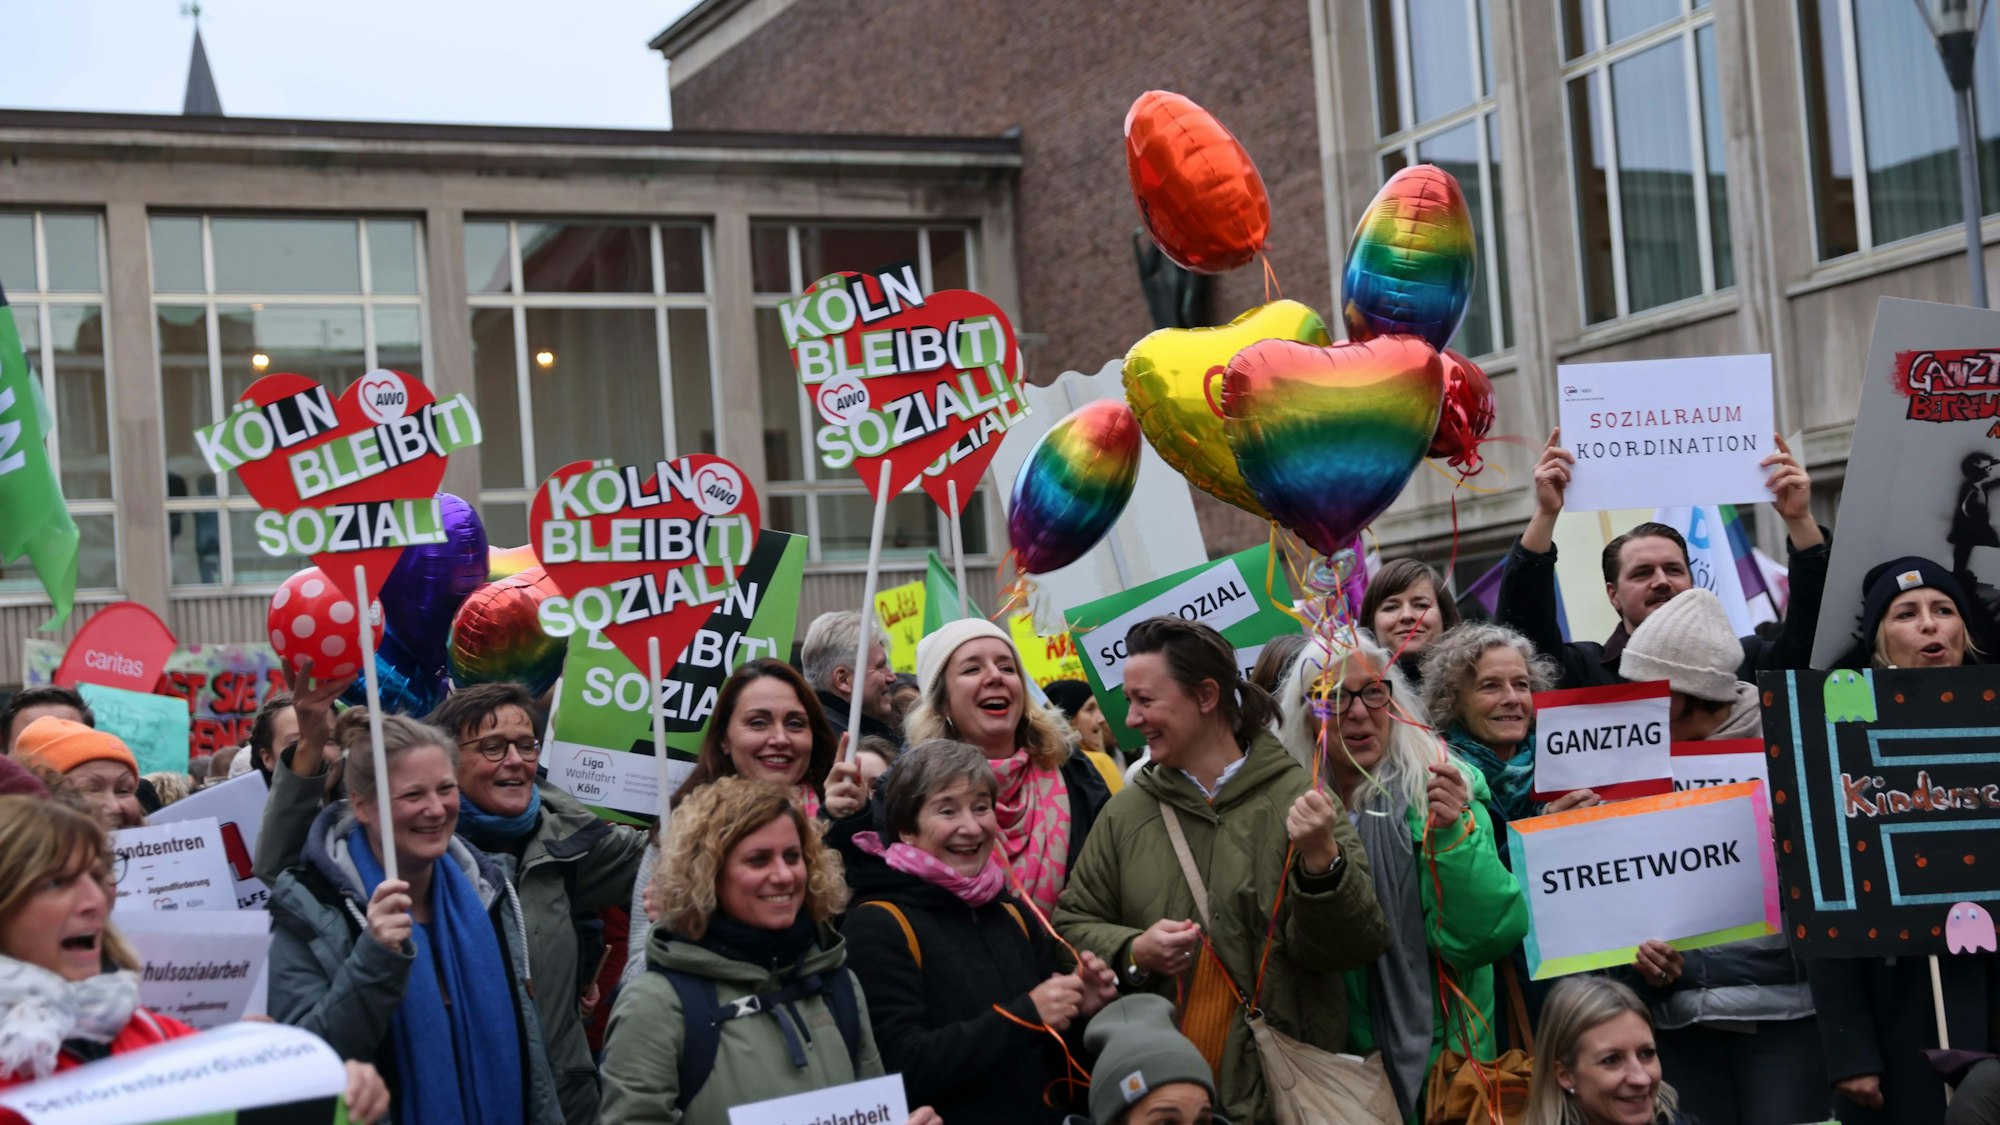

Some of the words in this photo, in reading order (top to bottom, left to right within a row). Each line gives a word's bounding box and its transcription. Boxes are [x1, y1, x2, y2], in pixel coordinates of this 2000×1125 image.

[780, 265, 924, 344] KÖLN
[799, 316, 1006, 384] BLEIB(T)
[376, 392, 404, 406] AWO
[816, 364, 1011, 468] SOZIAL!
[836, 390, 865, 411] AWO
[1590, 406, 1742, 428] SOZIALRAUM
[194, 385, 339, 474] KÖLN
[289, 393, 482, 500] BLEIB(T)
[902, 382, 1033, 491] ZIAL!
[1577, 435, 1757, 459] KOORDINATION
[549, 457, 695, 519] KÖLN
[705, 483, 737, 506] AWO
[255, 498, 448, 556] SOZIAL!
[543, 514, 753, 567] BLEIB(T)
[538, 556, 736, 637] SOZIAL!
[582, 757, 604, 769] Liga
[1546, 722, 1662, 755] GANZTAG
[566, 768, 616, 784] Wohlfahrt
[577, 783, 600, 795] Köln
[1542, 840, 1741, 894] STREETWORK
